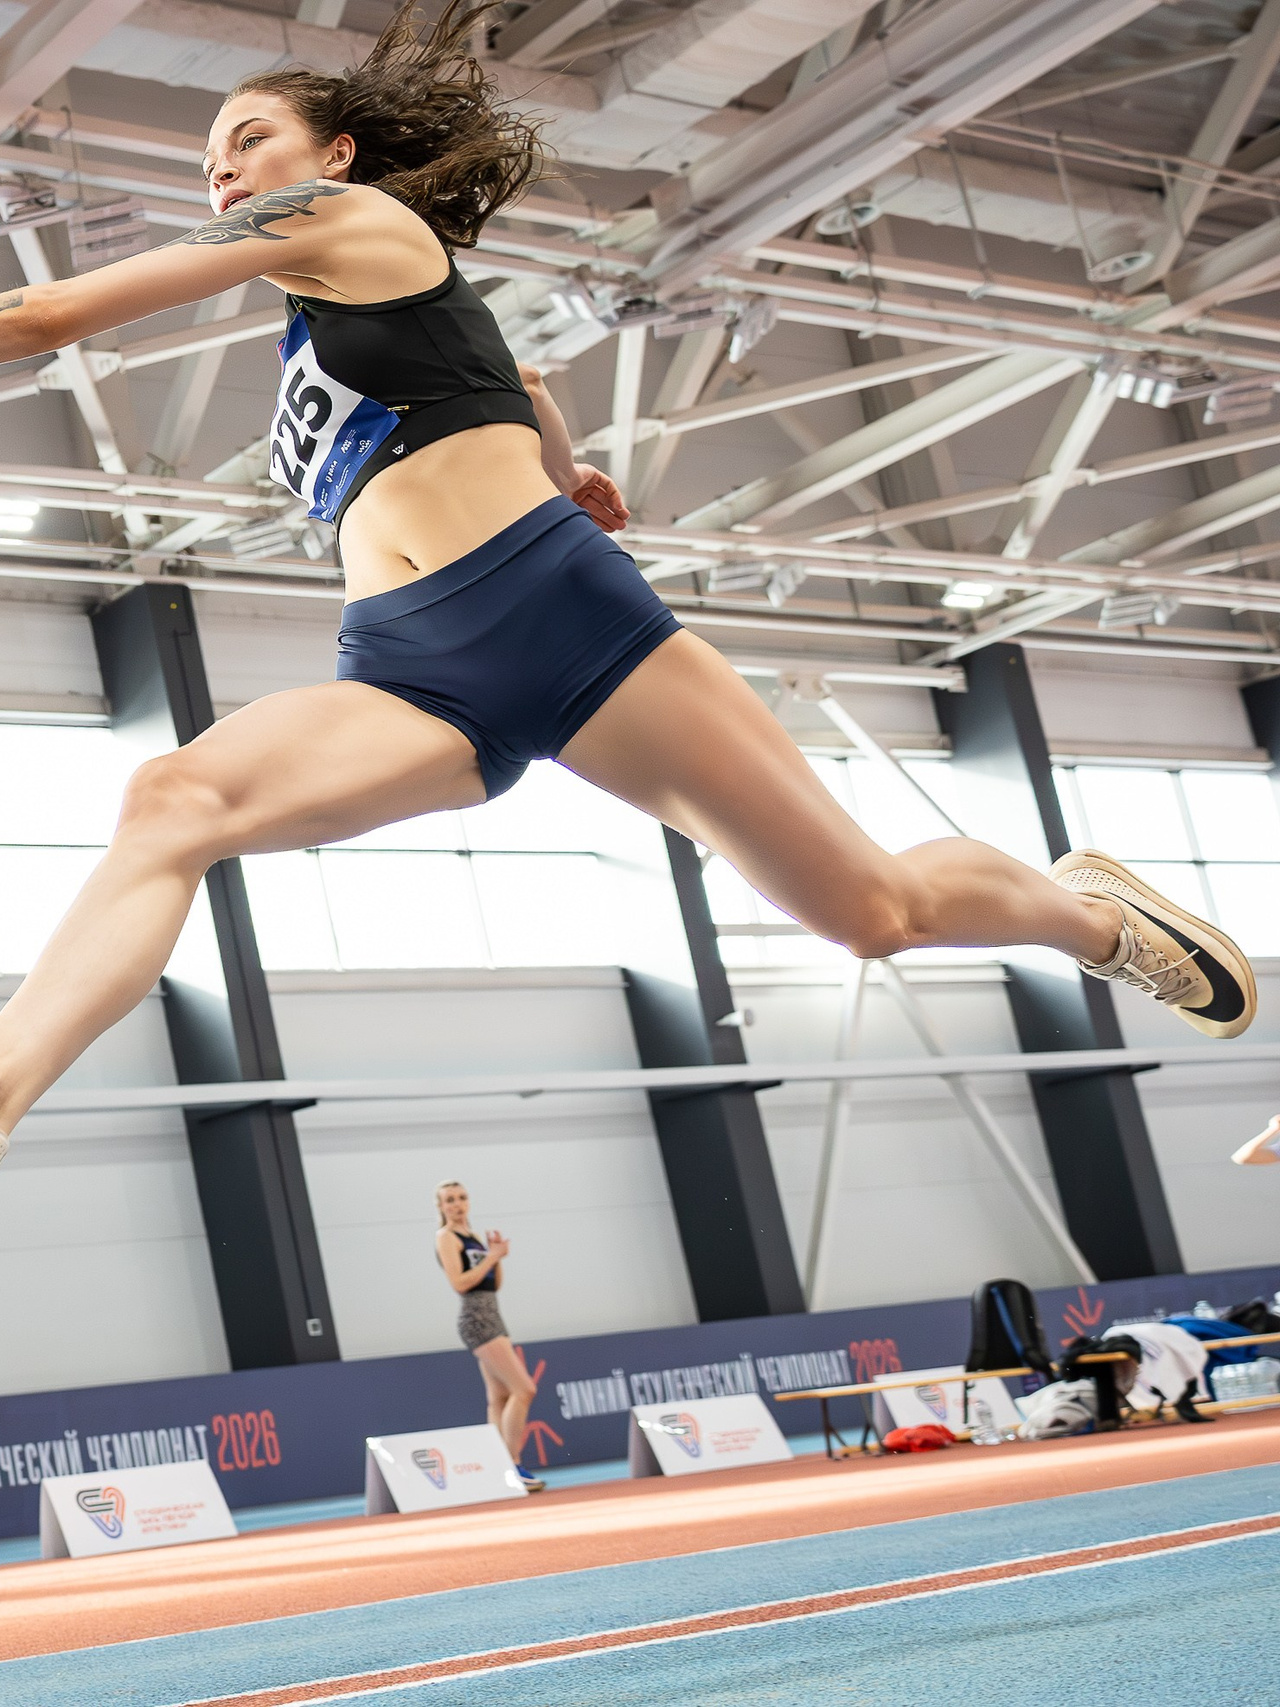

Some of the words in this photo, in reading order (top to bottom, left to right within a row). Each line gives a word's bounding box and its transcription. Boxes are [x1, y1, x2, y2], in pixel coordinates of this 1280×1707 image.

[272, 367, 332, 495] 225
[86, 1424, 210, 1473] ЧЕМПИОНАТ
[212, 1409, 282, 1471] 2026
